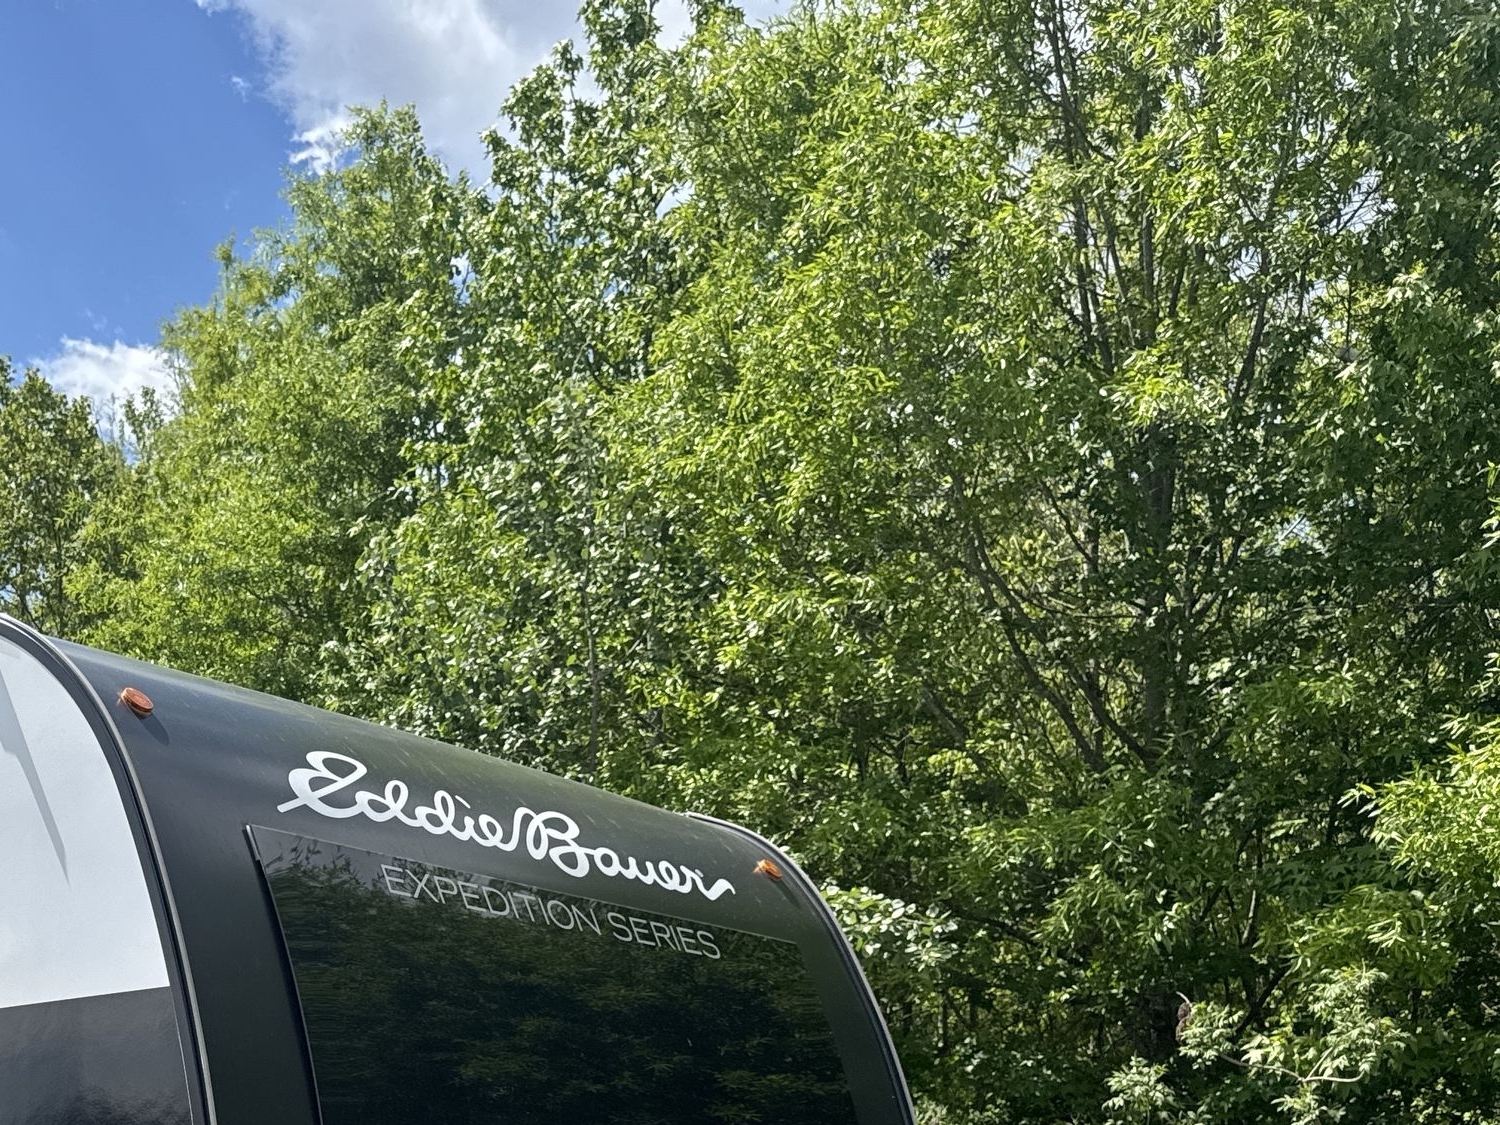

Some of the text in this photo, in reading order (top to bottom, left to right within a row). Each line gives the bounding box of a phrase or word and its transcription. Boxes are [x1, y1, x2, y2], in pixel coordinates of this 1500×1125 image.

[276, 750, 736, 902] Eddie Bauer
[380, 864, 722, 960] EXPEDITION SERIES
